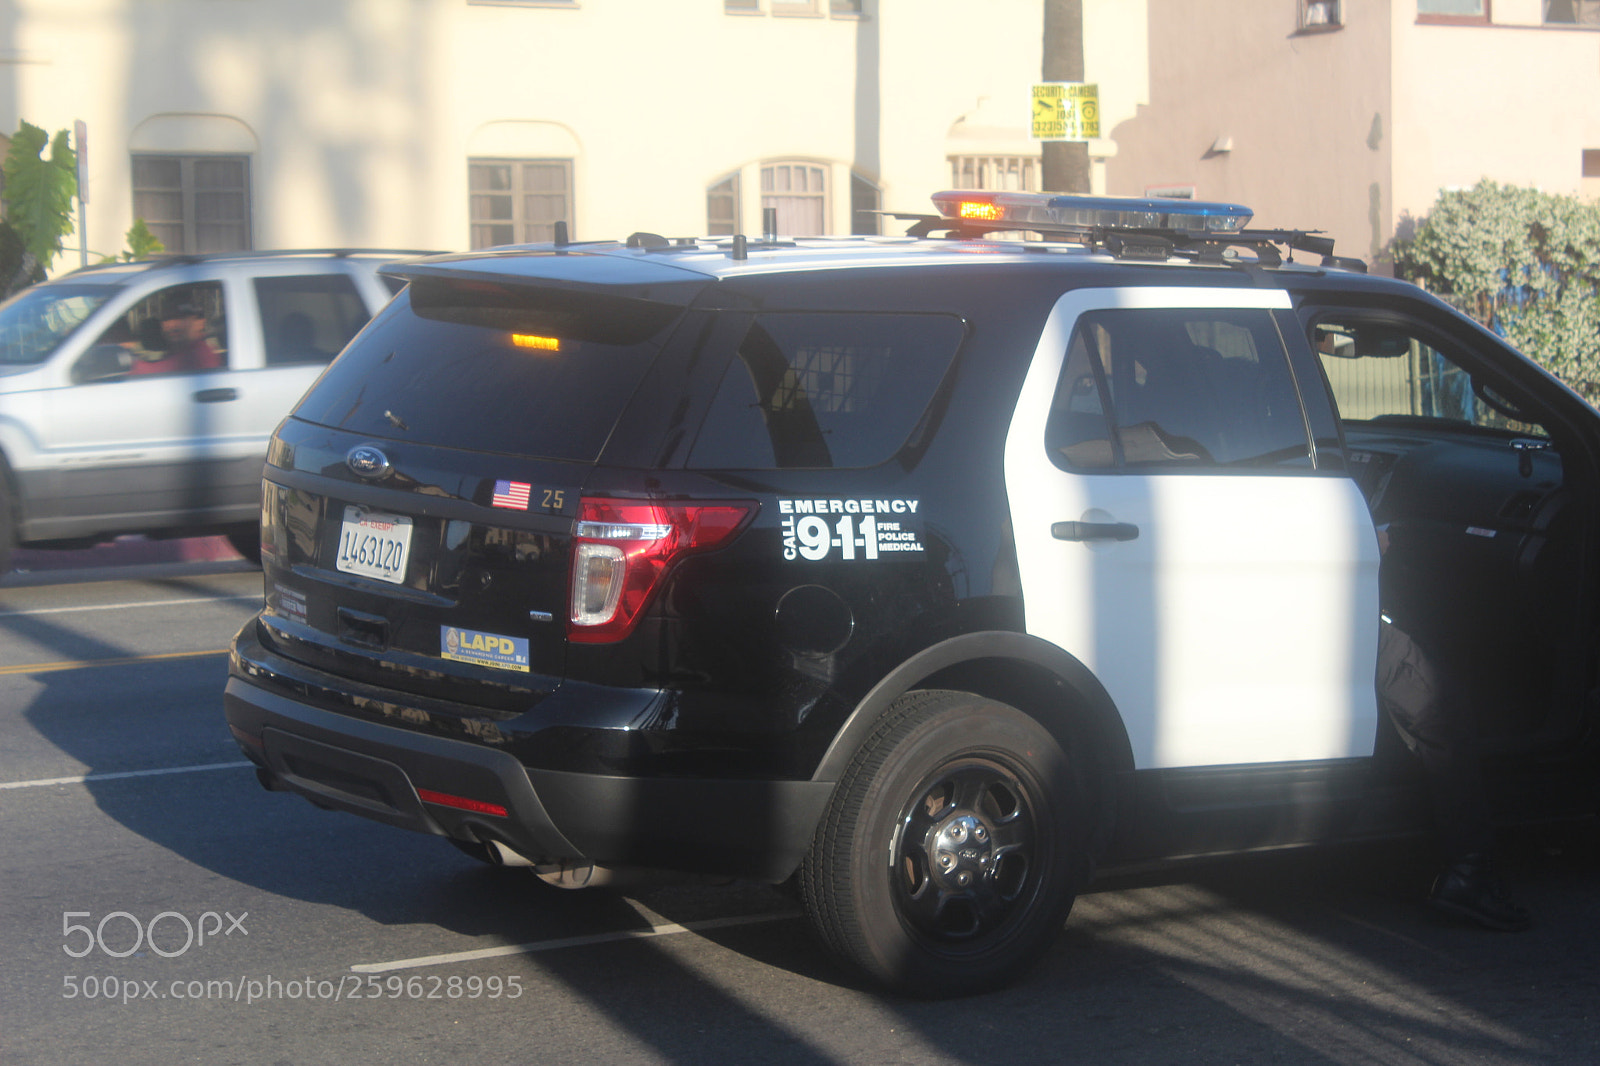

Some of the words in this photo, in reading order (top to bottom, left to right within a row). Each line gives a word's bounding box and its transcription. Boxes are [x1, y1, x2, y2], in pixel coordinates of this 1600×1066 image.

[1032, 85, 1066, 97] SECURITY
[541, 489, 565, 509] 25
[779, 499, 918, 513] EMERGENCY
[370, 519, 394, 532] EXEMPT
[877, 522, 900, 531] FIRE
[781, 515, 797, 561] CALL
[796, 515, 878, 561] 9-1-1
[878, 532, 915, 541] POLICE
[341, 531, 403, 572] 1463120
[878, 542, 924, 552] MEDICAL
[460, 631, 515, 655] LAPD
